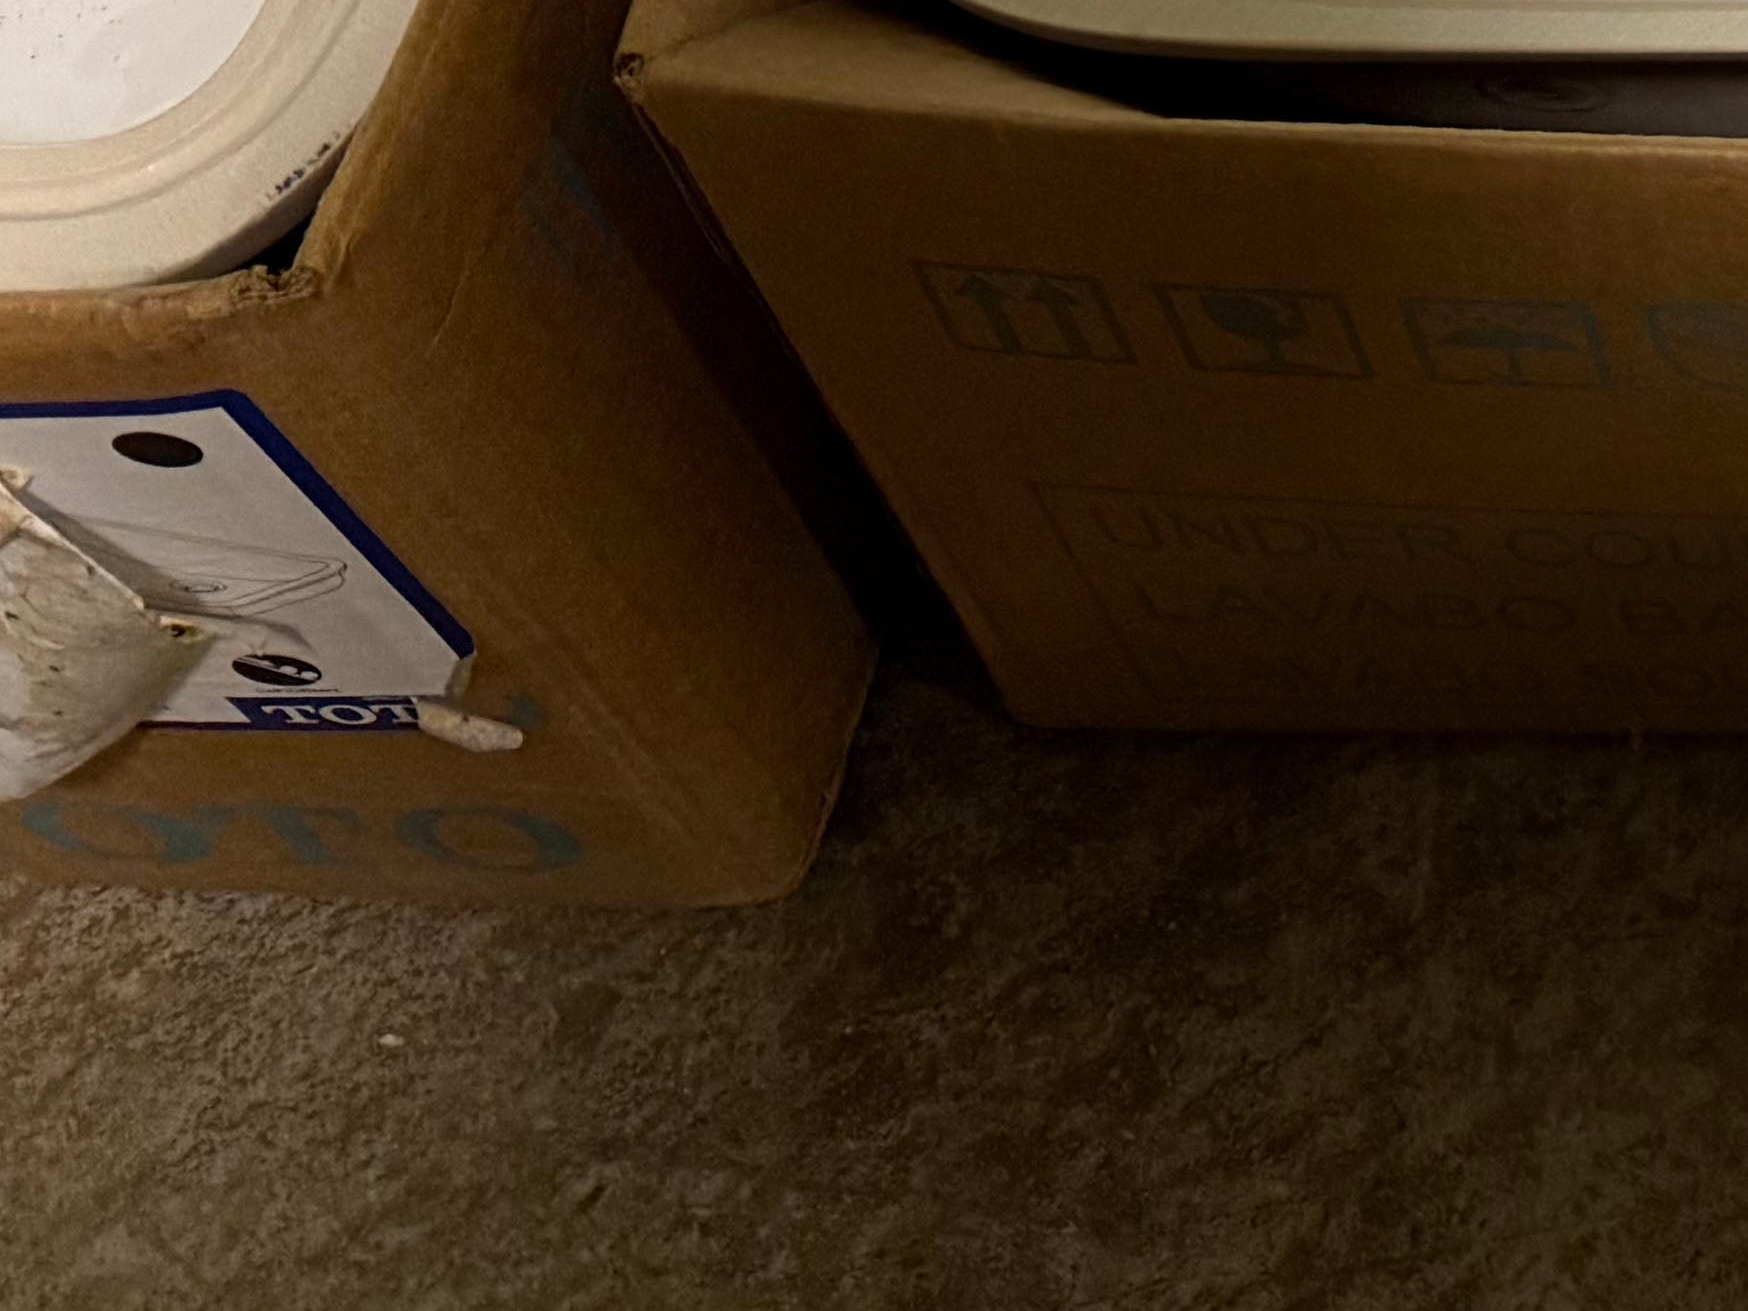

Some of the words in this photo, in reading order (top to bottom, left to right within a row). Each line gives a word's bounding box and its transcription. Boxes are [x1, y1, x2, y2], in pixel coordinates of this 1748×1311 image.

[1083, 503, 1475, 563] UNDER
[1133, 580, 1581, 634] LAVABO
[260, 703, 420, 725] TOT
